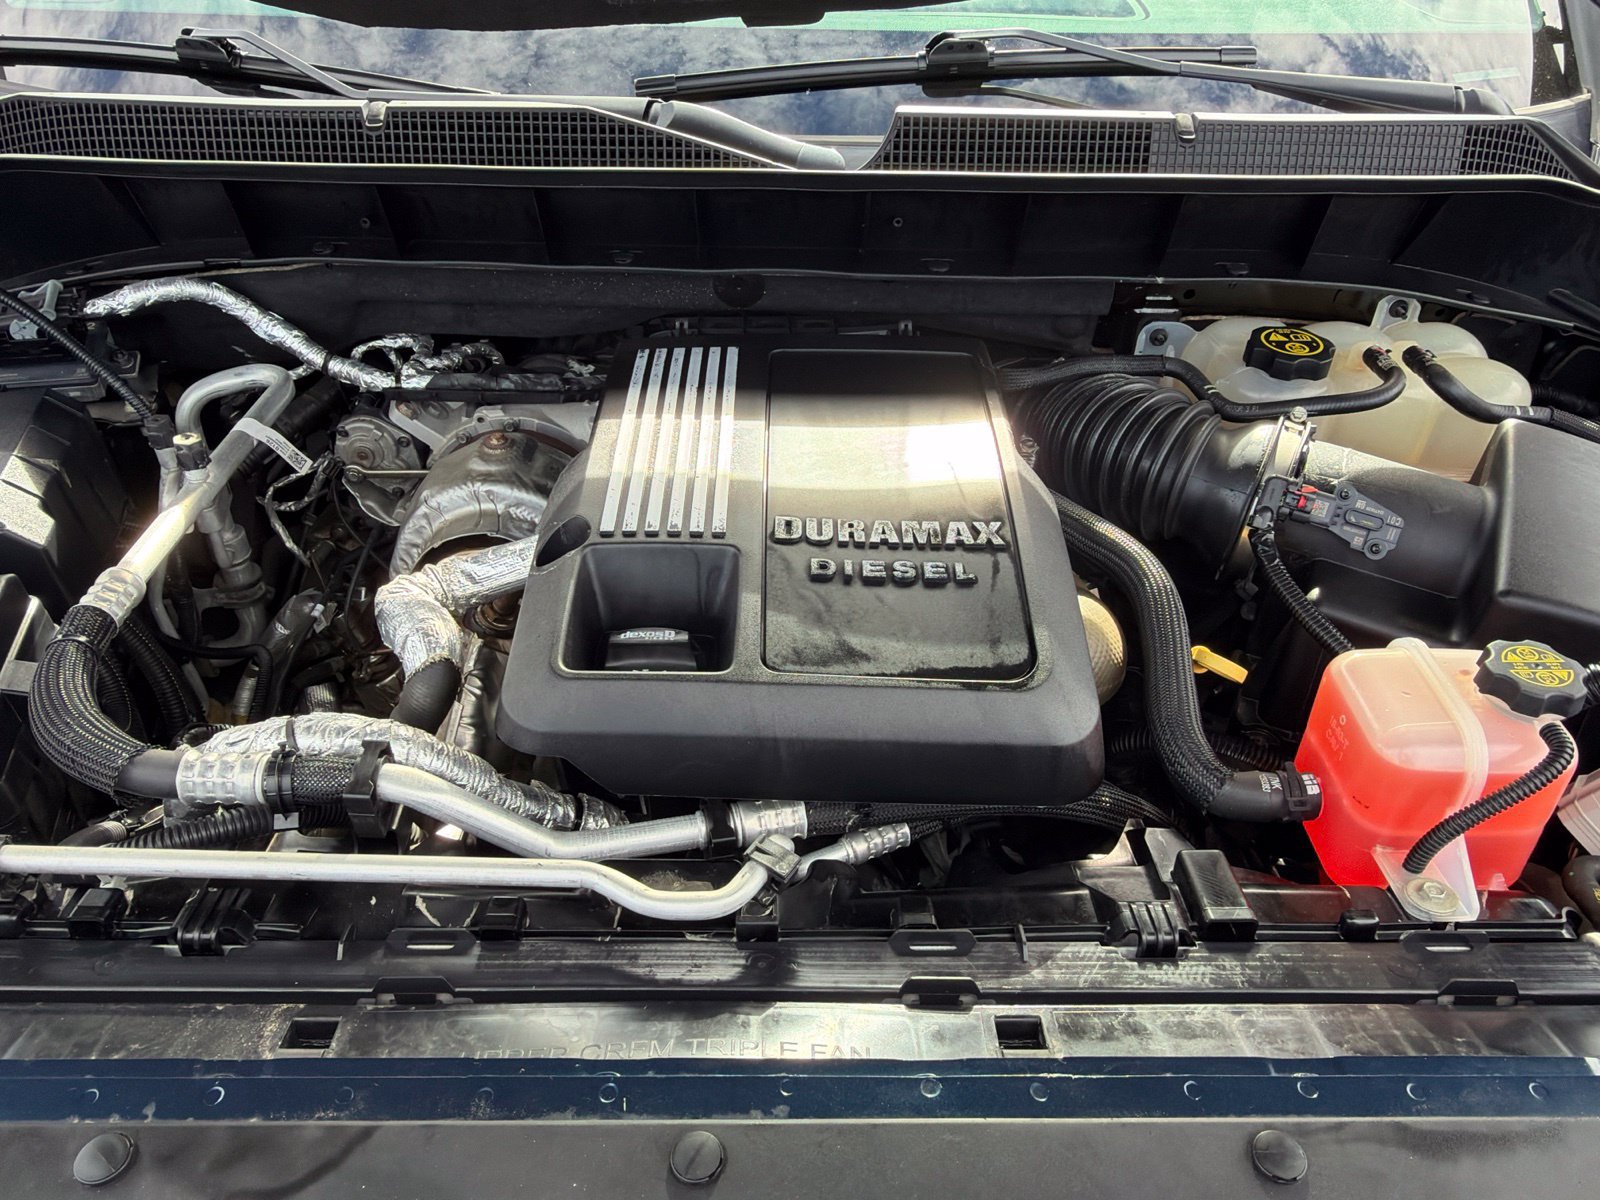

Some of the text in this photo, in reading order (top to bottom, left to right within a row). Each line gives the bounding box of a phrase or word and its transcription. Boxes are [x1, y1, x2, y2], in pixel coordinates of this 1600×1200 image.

[774, 515, 1006, 549] DURAMAX
[810, 557, 978, 585] DIESEL
[811, 1043, 871, 1060] FAN
